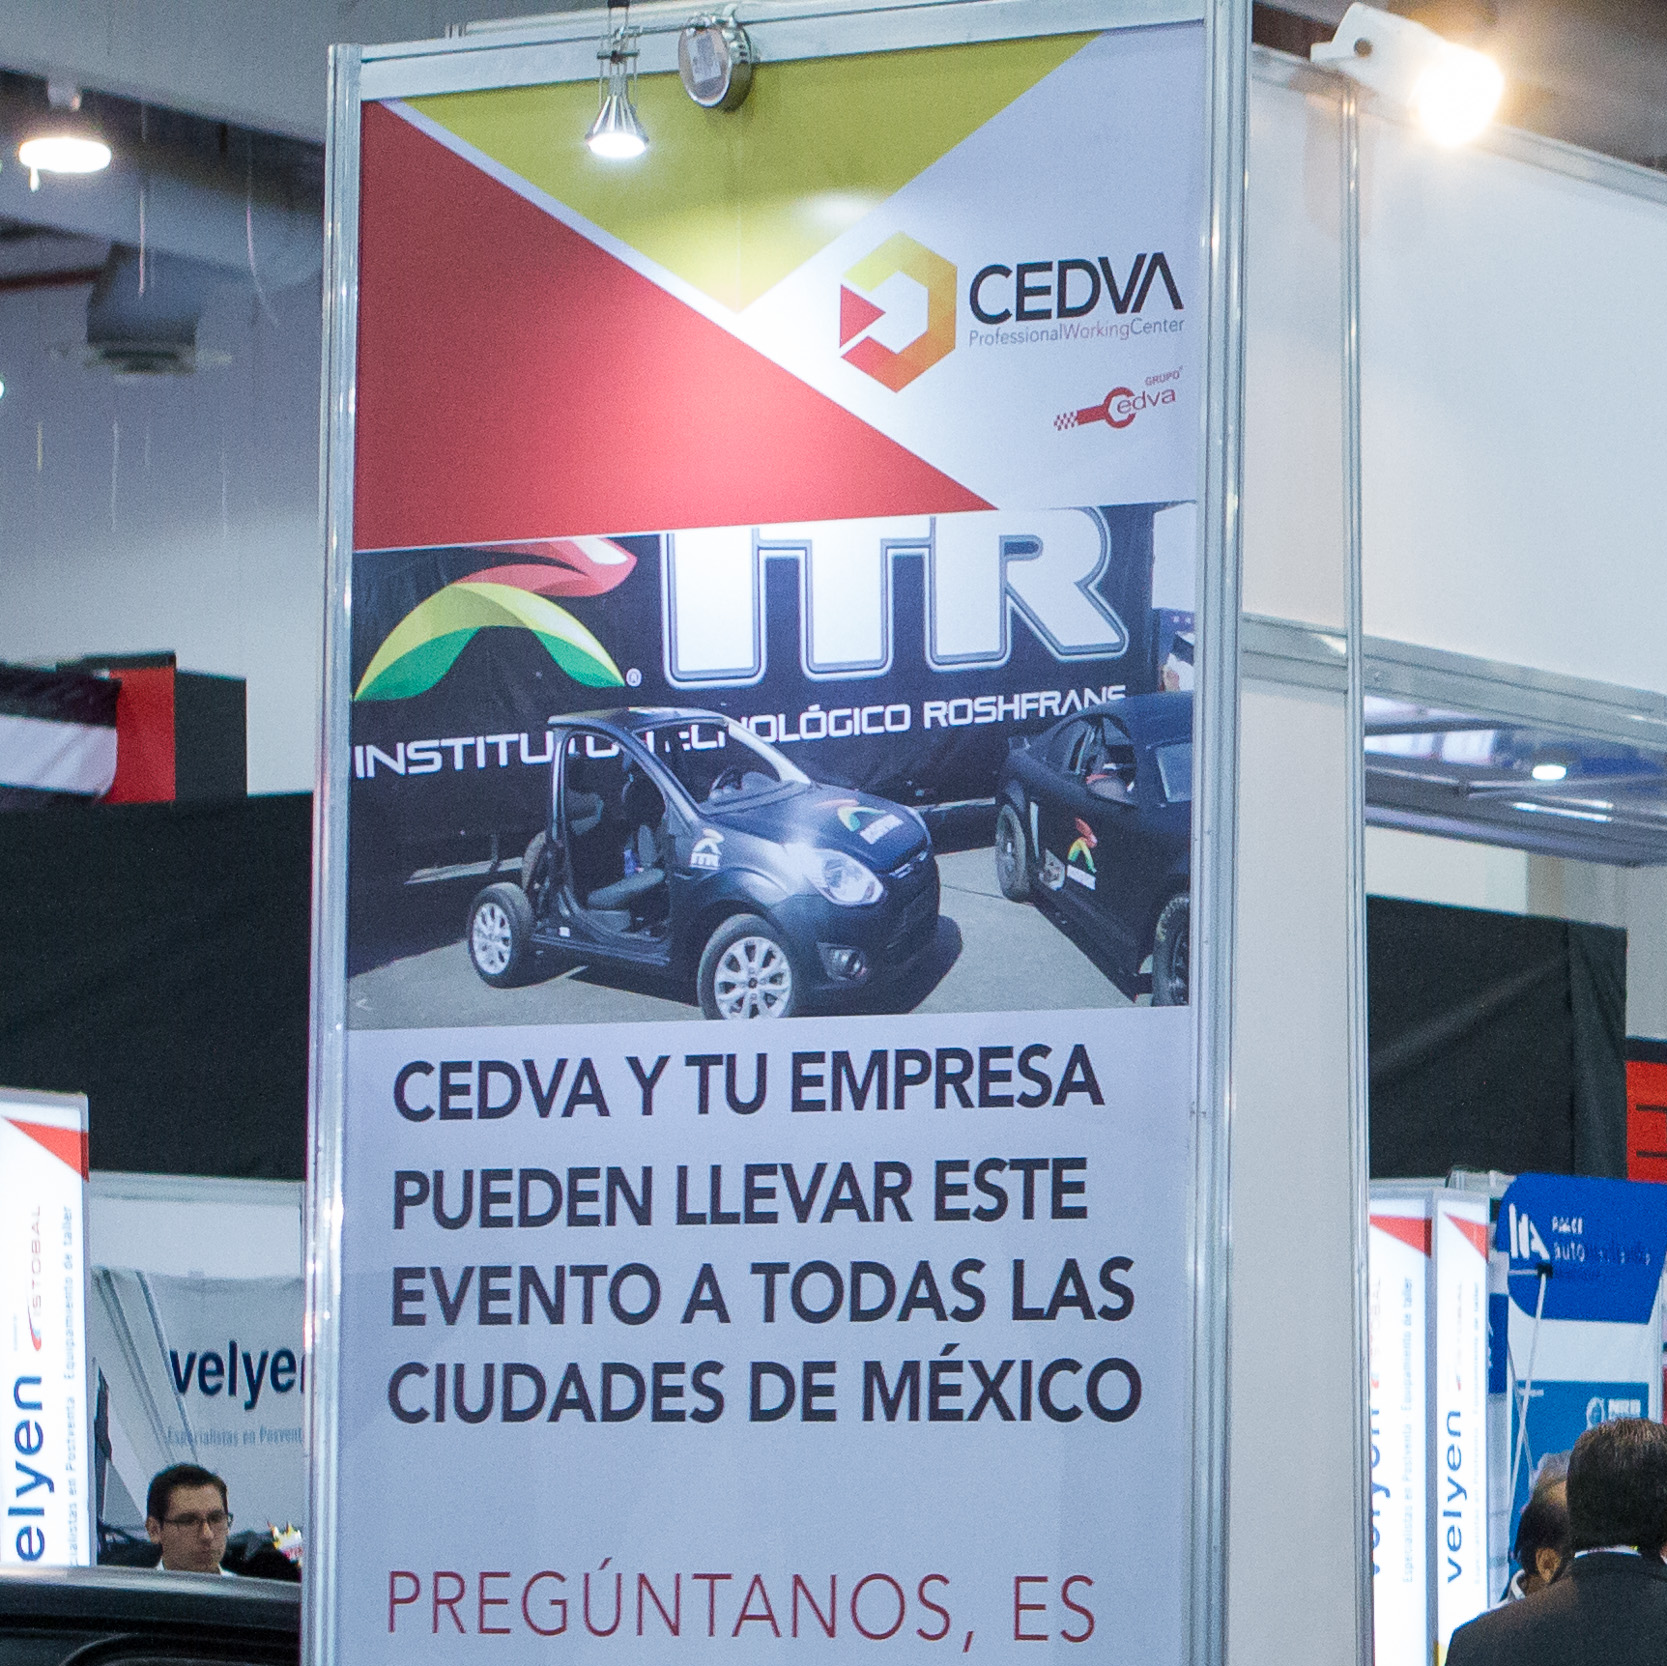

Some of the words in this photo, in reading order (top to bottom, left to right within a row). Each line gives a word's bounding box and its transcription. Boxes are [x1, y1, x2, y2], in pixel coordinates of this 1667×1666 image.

[969, 252, 1184, 325] CEDVA
[969, 318, 1184, 347] ProfessionalWorkingCenter
[1144, 369, 1180, 386] GRUPO
[354, 731, 620, 779] INSTITUO
[394, 1058, 610, 1121] CEDVA
[627, 1056, 670, 1115] Y
[686, 1053, 767, 1114] TU
[791, 1044, 1105, 1112] EMPRESA
[393, 1167, 652, 1230] PUEDEN
[676, 1162, 914, 1225] LLEVAR
[934, 1157, 1088, 1222] ESTE
[391, 1263, 661, 1326] EVENTO
[682, 1265, 731, 1325] A
[751, 1258, 986, 1324] TODAS
[1012, 1257, 1135, 1321] LAS
[388, 1361, 725, 1424] CIUDADES
[750, 1362, 837, 1424] DE
[862, 1345, 1143, 1423] MÉXICO
[1443, 1410, 1467, 1583] velyen
[387, 1558, 976, 1653] PREGÚNTANOS,
[1012, 1575, 1097, 1643] ES
